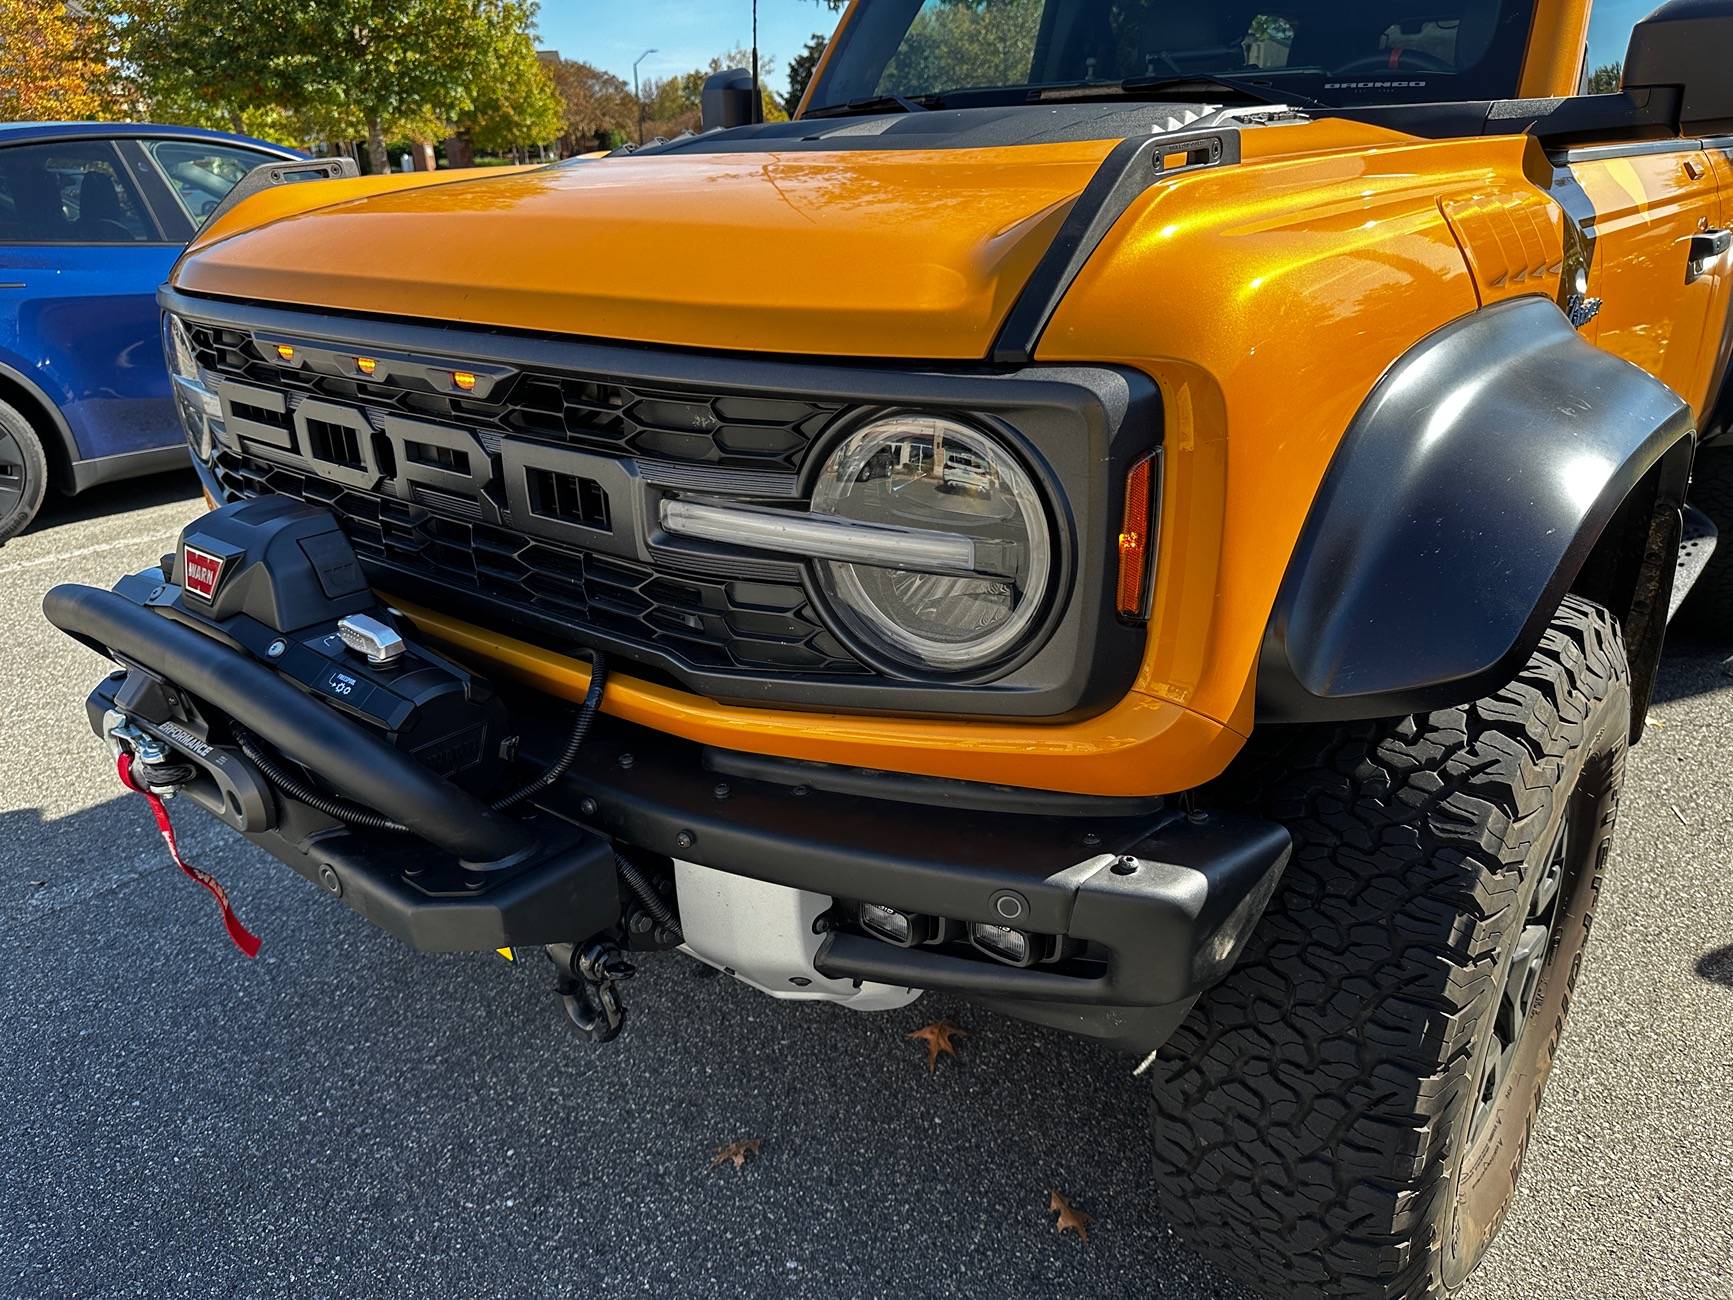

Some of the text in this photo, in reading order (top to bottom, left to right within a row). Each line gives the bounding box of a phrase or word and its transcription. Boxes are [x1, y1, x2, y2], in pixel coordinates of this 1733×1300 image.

[1324, 81, 1426, 89] BRONCO
[217, 379, 644, 562] FORD
[188, 561, 214, 586] WARN
[157, 721, 215, 757] ERFORMANCE
